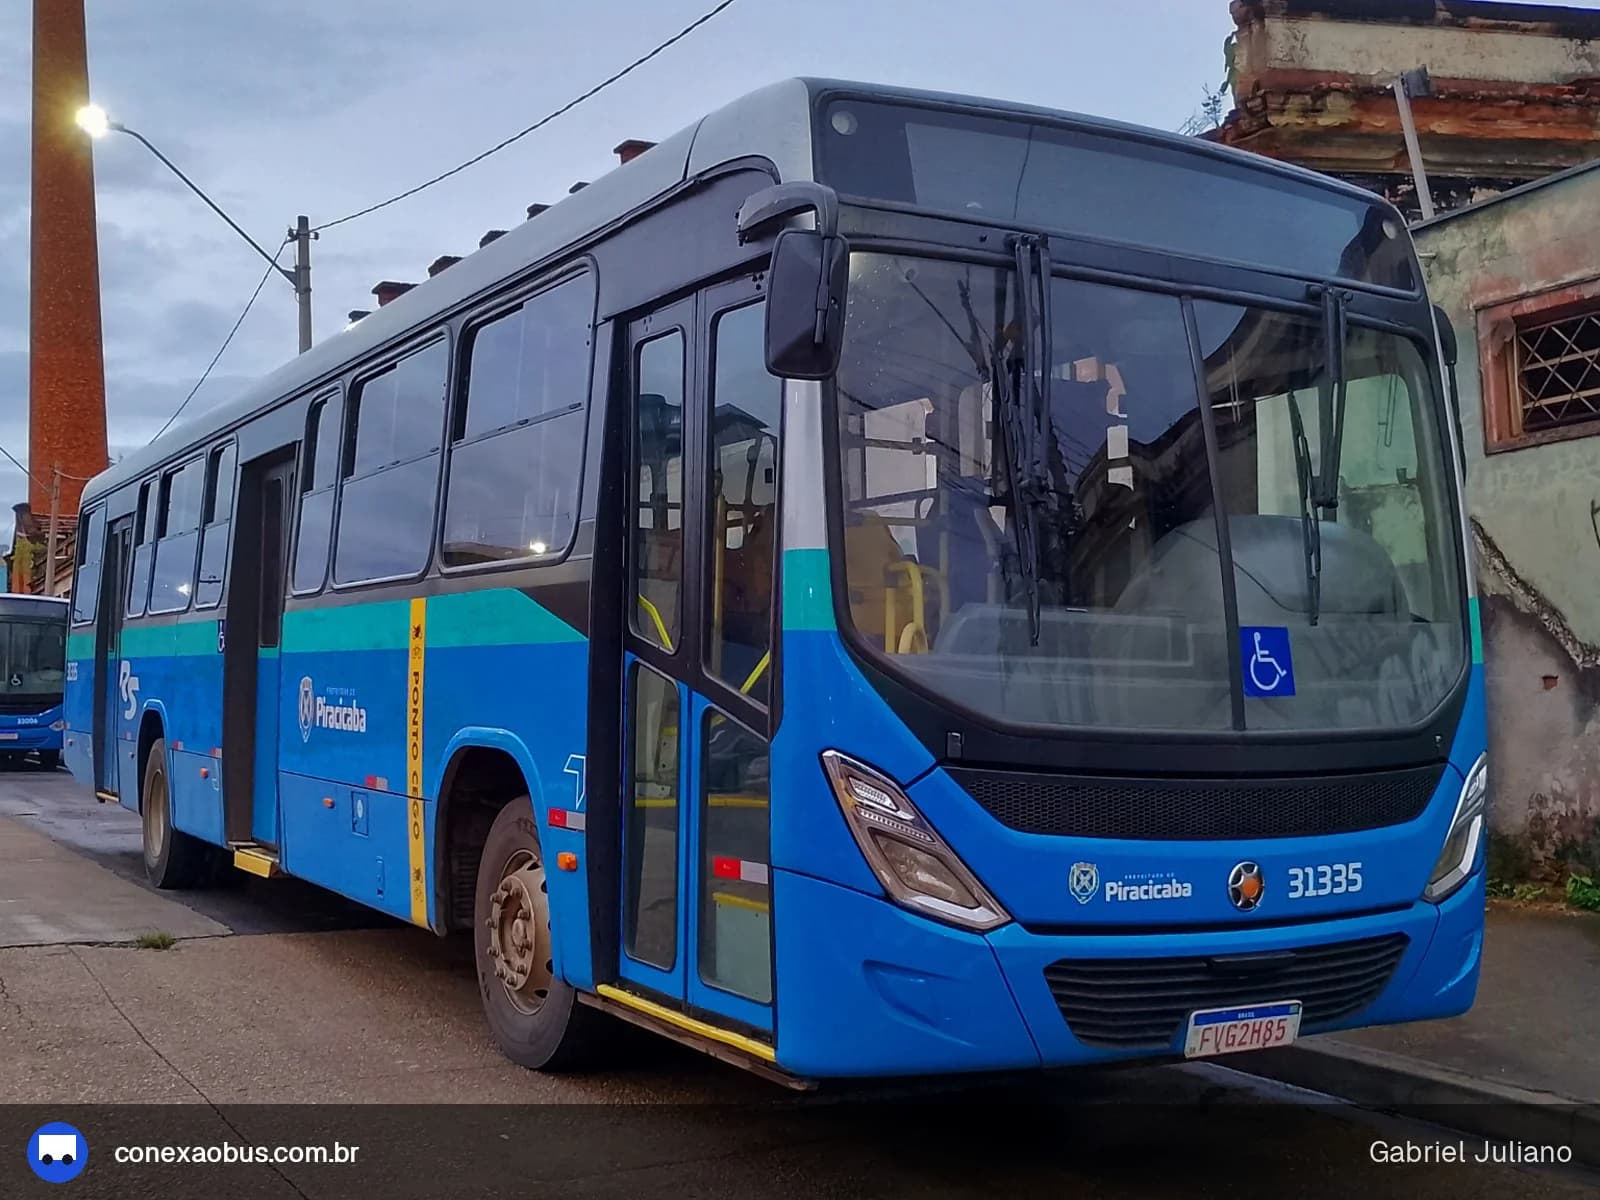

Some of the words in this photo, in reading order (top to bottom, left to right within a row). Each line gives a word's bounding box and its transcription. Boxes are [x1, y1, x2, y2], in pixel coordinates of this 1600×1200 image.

[316, 695, 366, 733] Piracicaba
[411, 671, 420, 761] PONTO
[411, 770, 421, 840] CEGO
[1105, 879, 1193, 902] Piracicaba
[1288, 862, 1363, 899] 31335
[1200, 1018, 1288, 1053] FVG2H85
